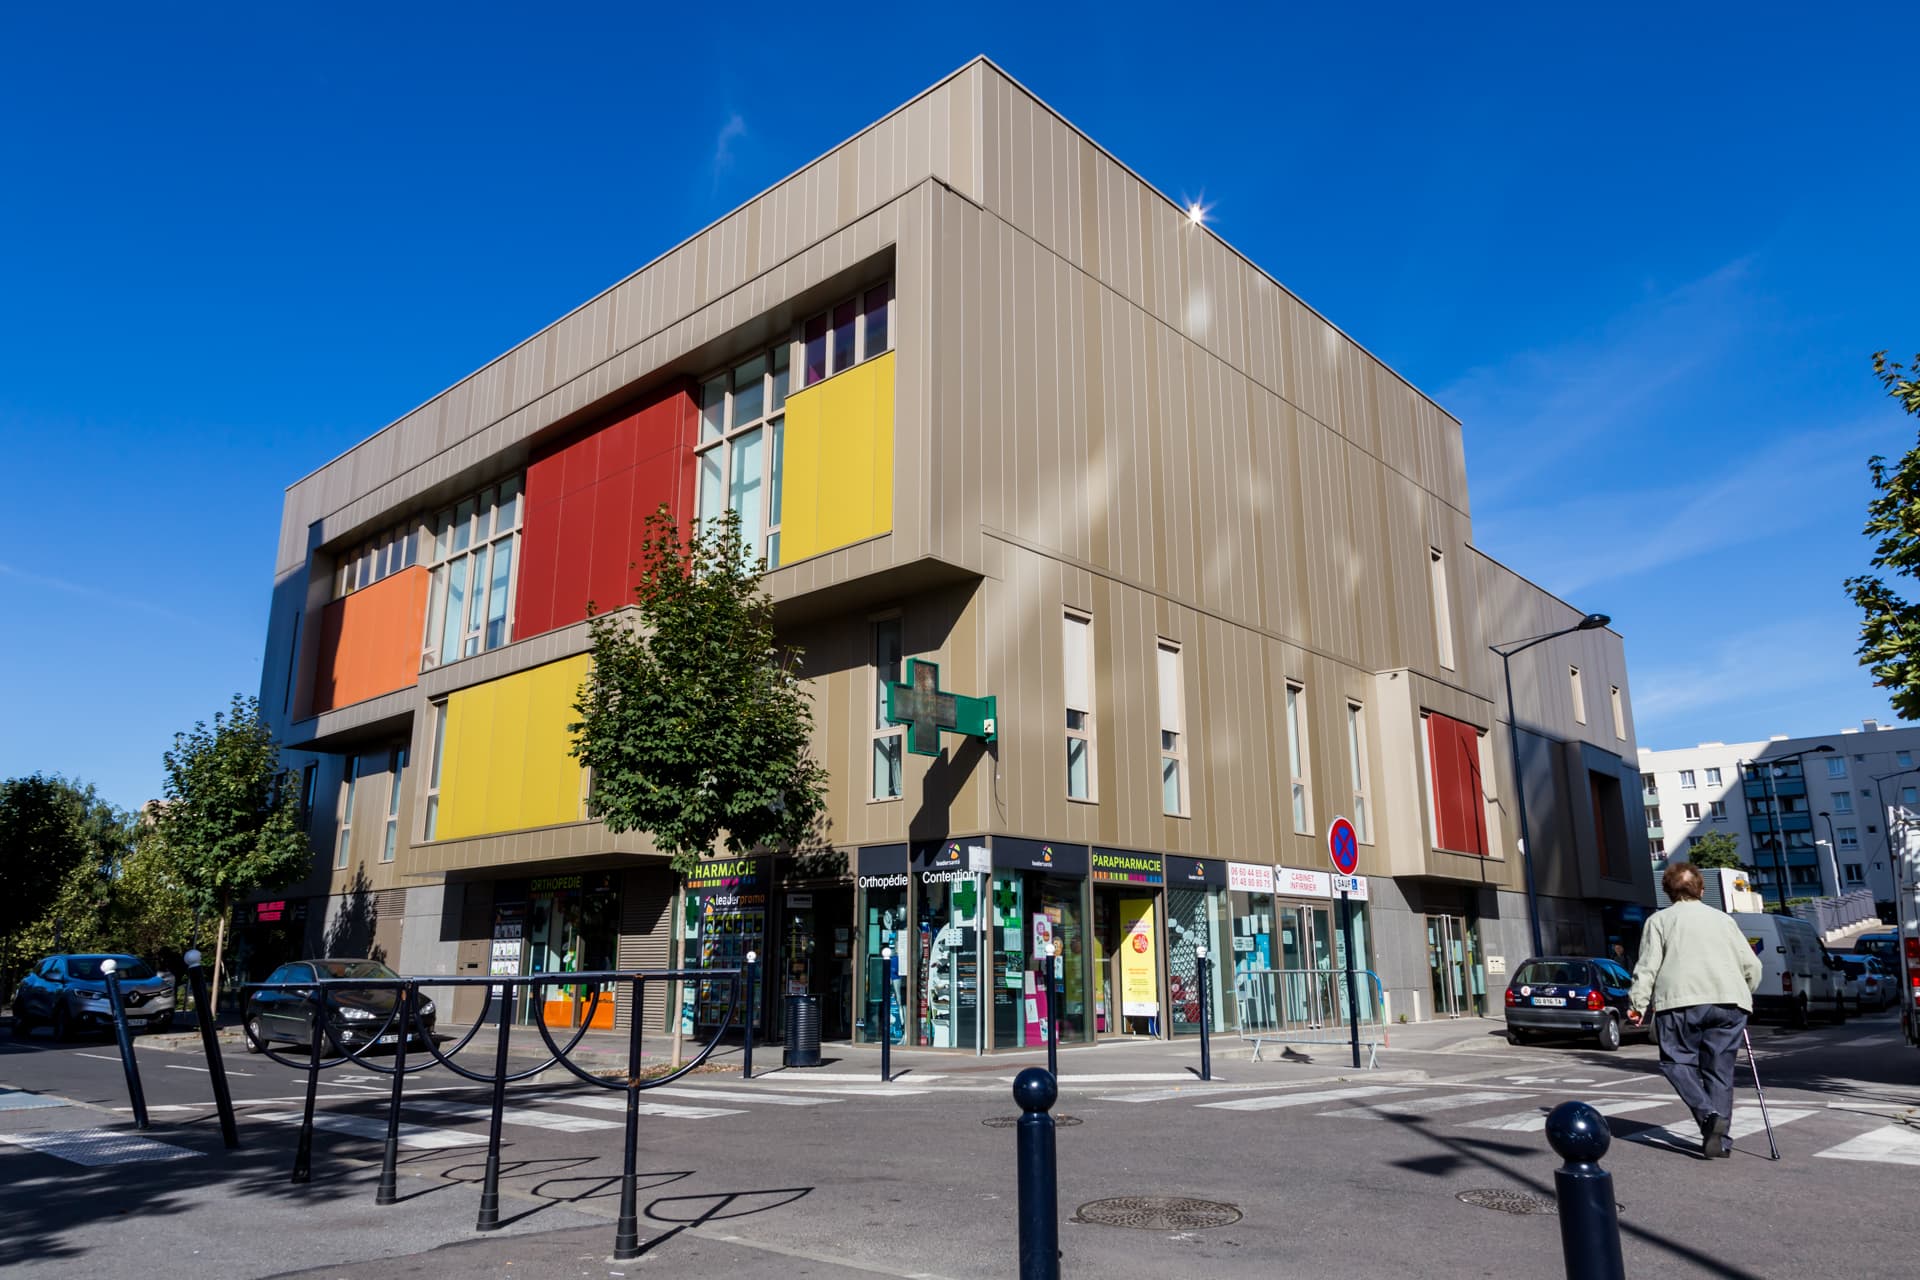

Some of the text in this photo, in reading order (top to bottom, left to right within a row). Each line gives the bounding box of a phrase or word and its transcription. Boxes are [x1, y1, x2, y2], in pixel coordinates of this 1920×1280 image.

[1092, 854, 1162, 872] PARAPHARMACIE
[531, 876, 581, 890] ORTHOPEDIE
[858, 874, 908, 890] Orthopédie
[922, 869, 976, 885] Contention
[1337, 879, 1351, 888] SAUF
[715, 893, 765, 907] leaderpromo
